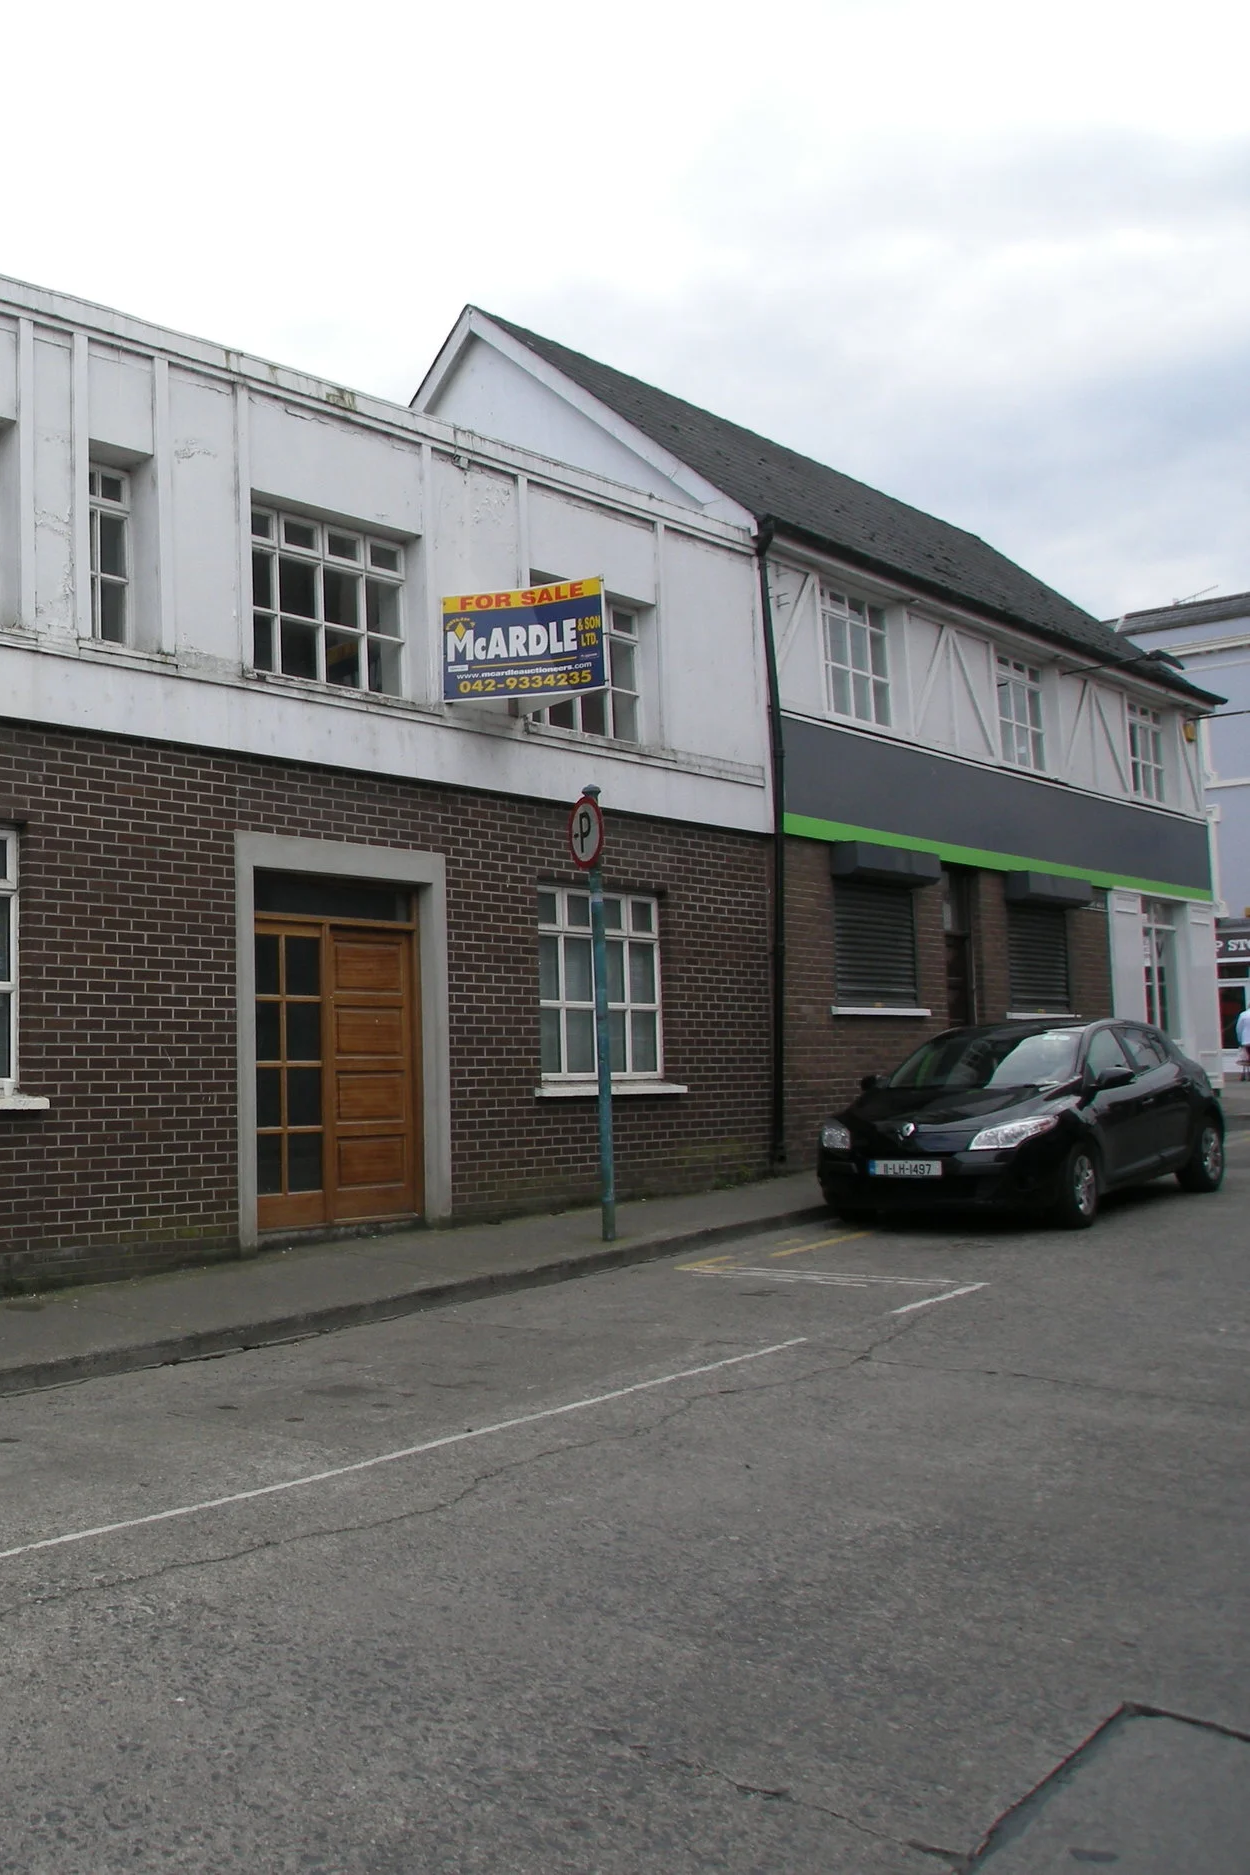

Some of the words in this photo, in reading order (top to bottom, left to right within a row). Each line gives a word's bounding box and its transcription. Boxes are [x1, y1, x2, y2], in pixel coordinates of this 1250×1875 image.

[459, 593, 511, 611] FOR
[521, 581, 584, 605] SALE
[577, 618, 584, 631] &
[584, 615, 601, 630] SON
[581, 632, 598, 647] LTD.
[456, 661, 592, 680] www.mcardleauctioneers.com
[459, 670, 592, 694] 042-9334235
[579, 811, 591, 853] P
[883, 1163, 932, 1175] 11-LH-1497
